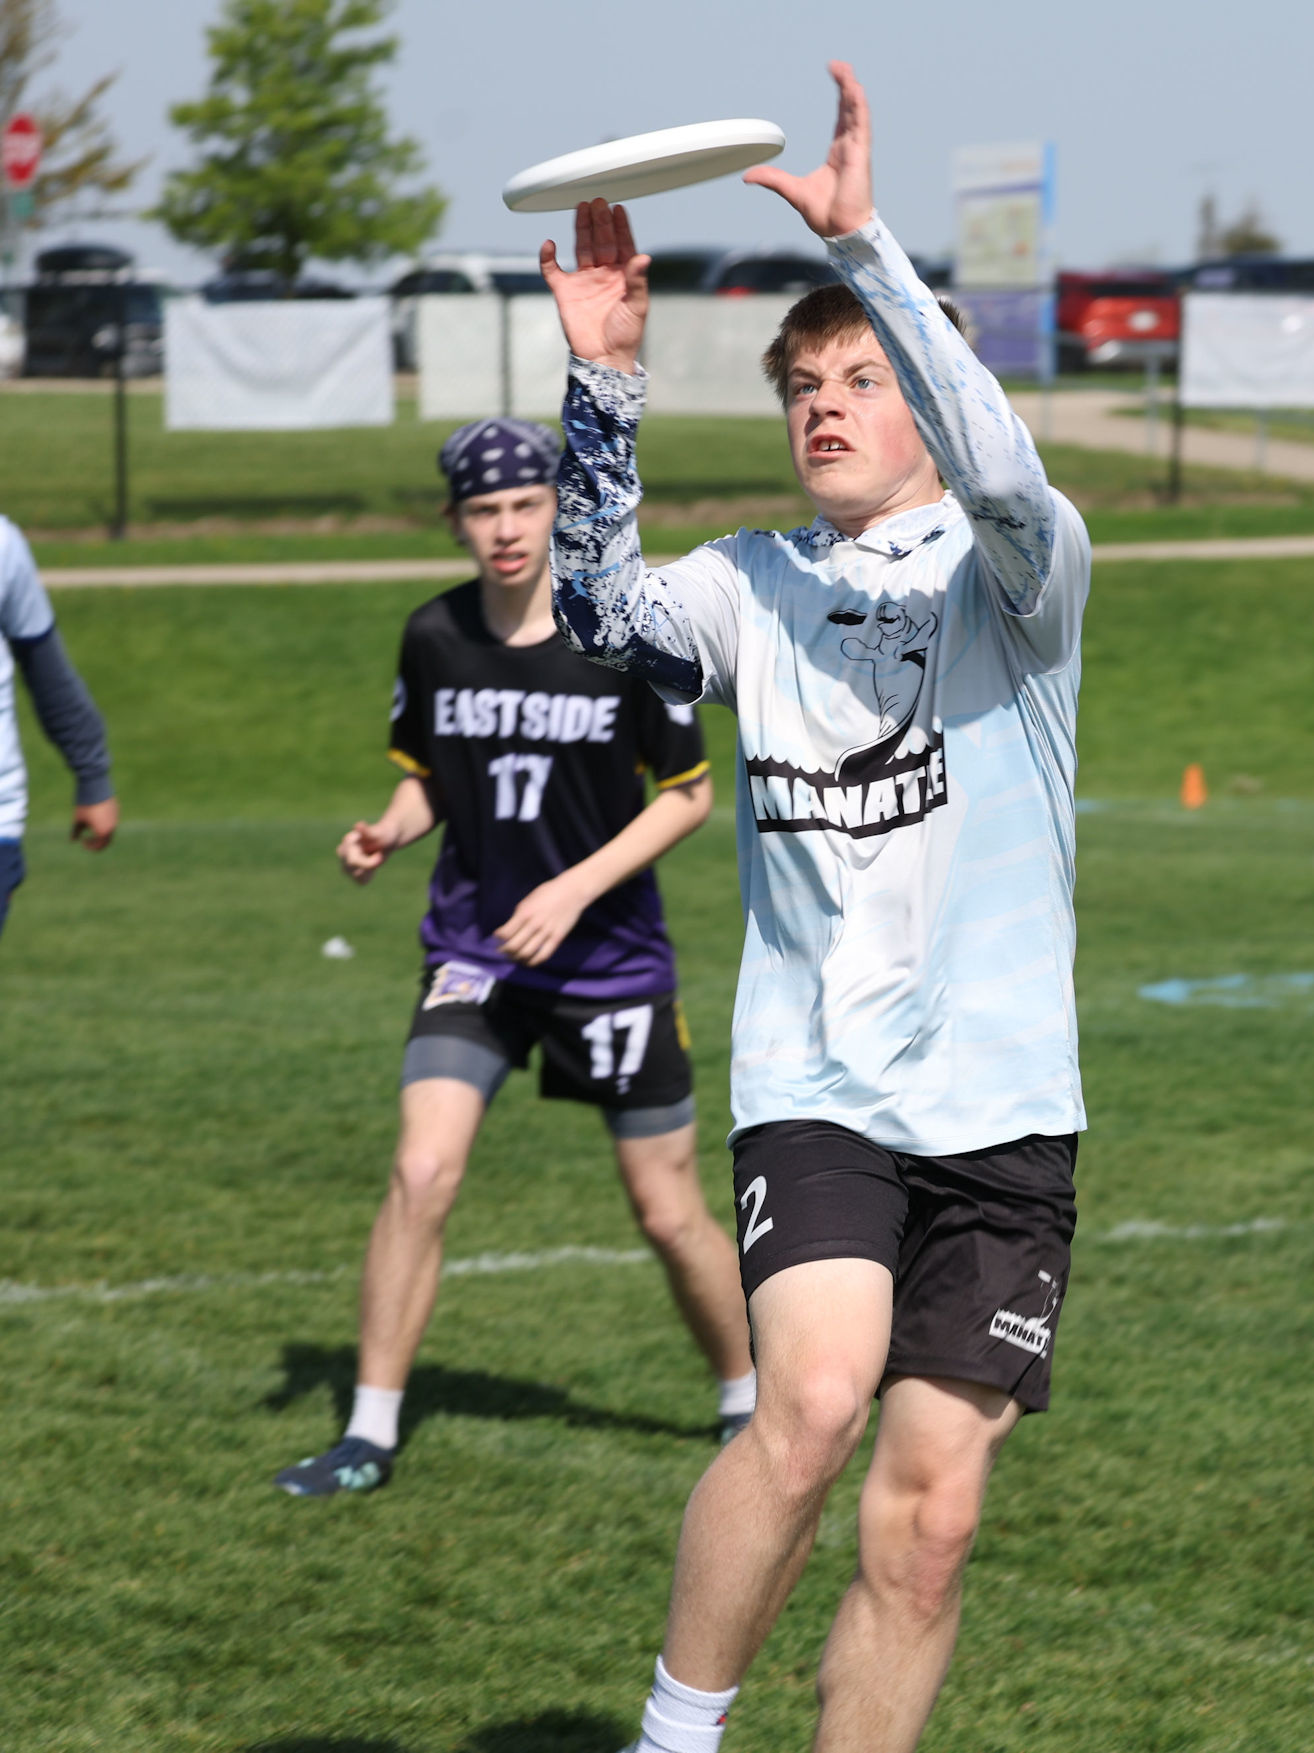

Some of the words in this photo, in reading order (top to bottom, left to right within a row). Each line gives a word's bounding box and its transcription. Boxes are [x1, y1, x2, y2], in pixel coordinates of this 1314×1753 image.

[434, 687, 621, 743] EASTSIDE
[488, 752, 553, 822] 17
[750, 748, 944, 829] MANATE
[582, 1004, 652, 1079] 17
[740, 1175, 774, 1255] 2
